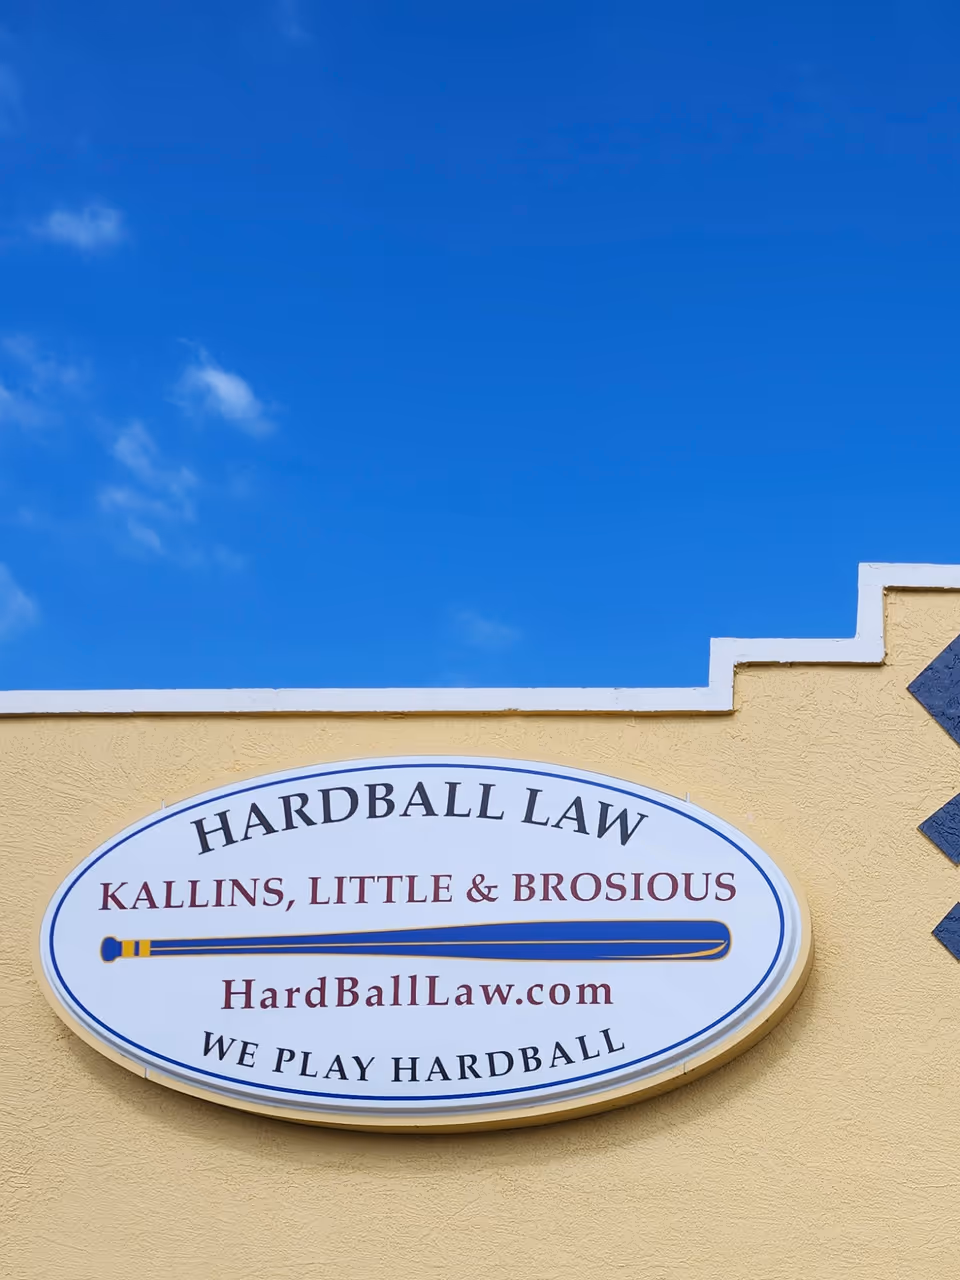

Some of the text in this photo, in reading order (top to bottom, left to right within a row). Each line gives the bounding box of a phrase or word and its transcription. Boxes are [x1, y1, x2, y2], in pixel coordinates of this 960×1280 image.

[190, 781, 649, 856] HARDBALL LAW
[99, 871, 738, 912] KALLINS, LITTLE & BROSIOUS
[221, 975, 614, 1010] HardBallLaw.com
[202, 1026, 626, 1083] WE PLAY HARDBALL
